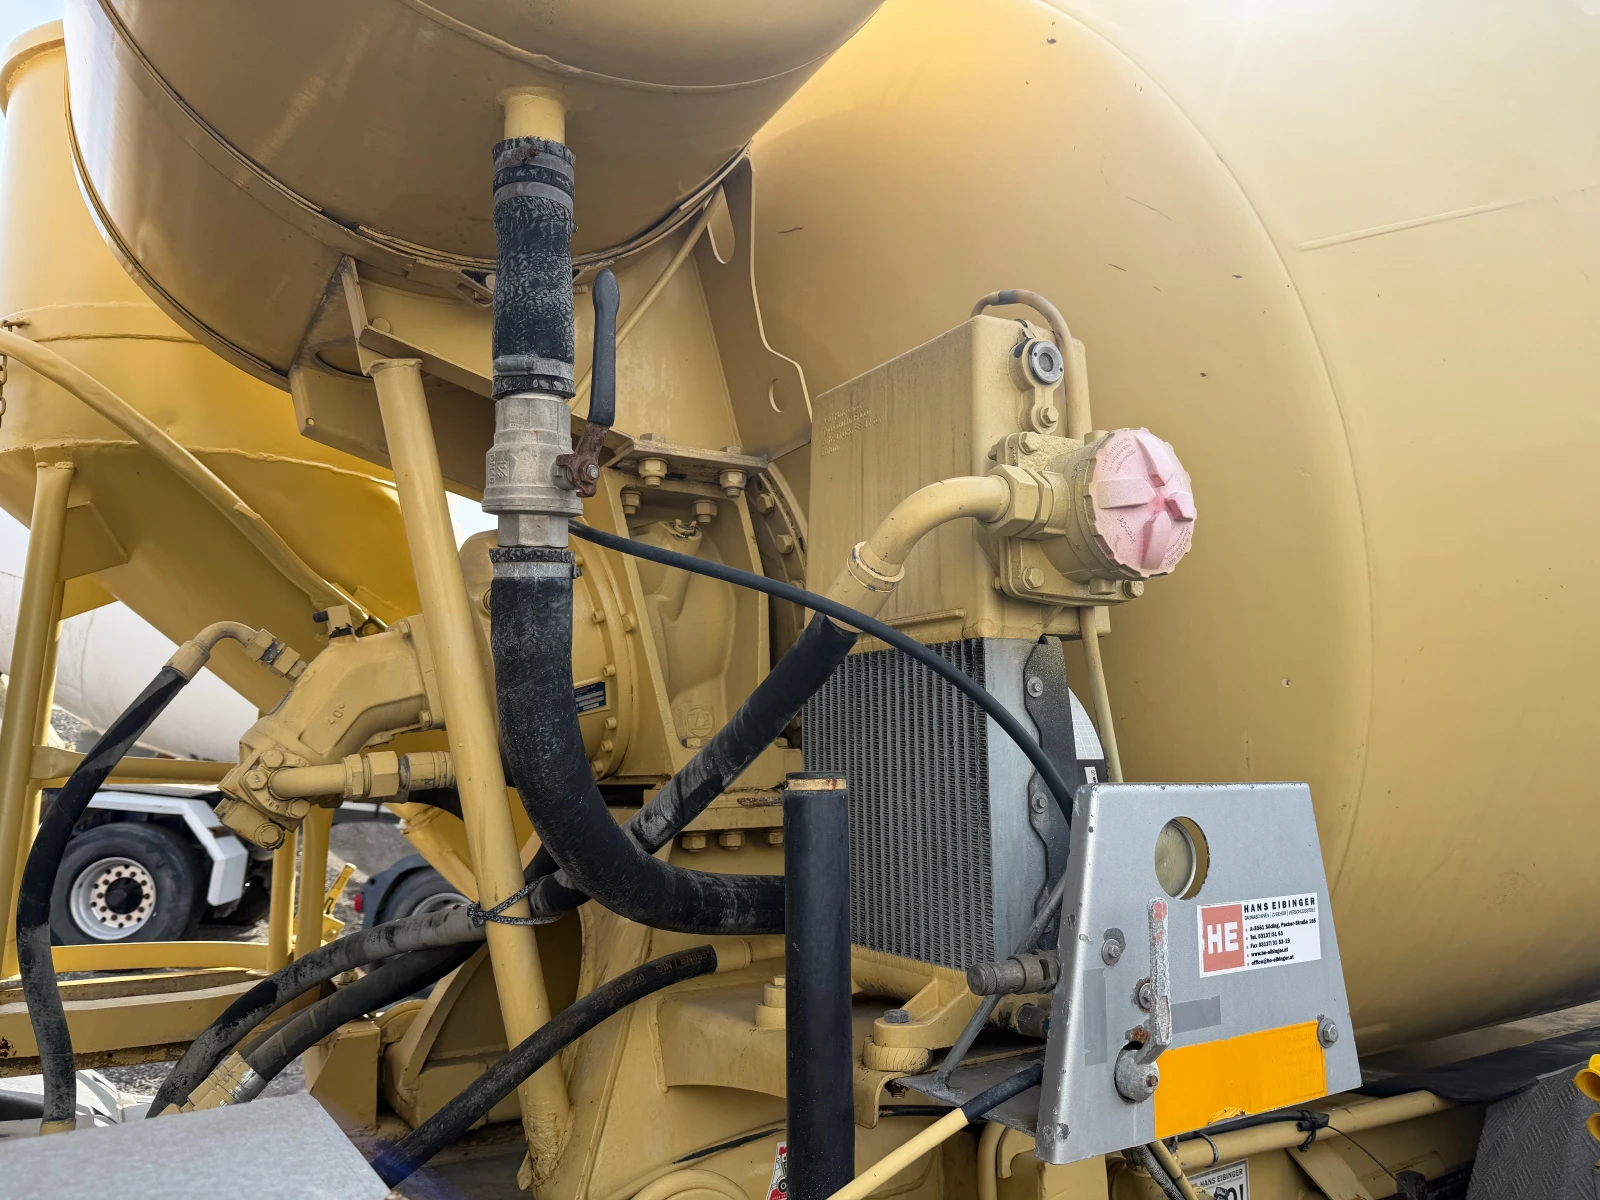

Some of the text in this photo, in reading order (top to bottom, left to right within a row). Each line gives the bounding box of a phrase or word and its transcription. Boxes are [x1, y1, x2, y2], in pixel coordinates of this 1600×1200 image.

[1244, 898, 1315, 913] HANS EIBINGER
[1206, 922, 1239, 954] HE
[655, 961, 673, 975] DIN
[1200, 1176, 1216, 1187] HANS
[1217, 1168, 1243, 1182] EIBINGER
